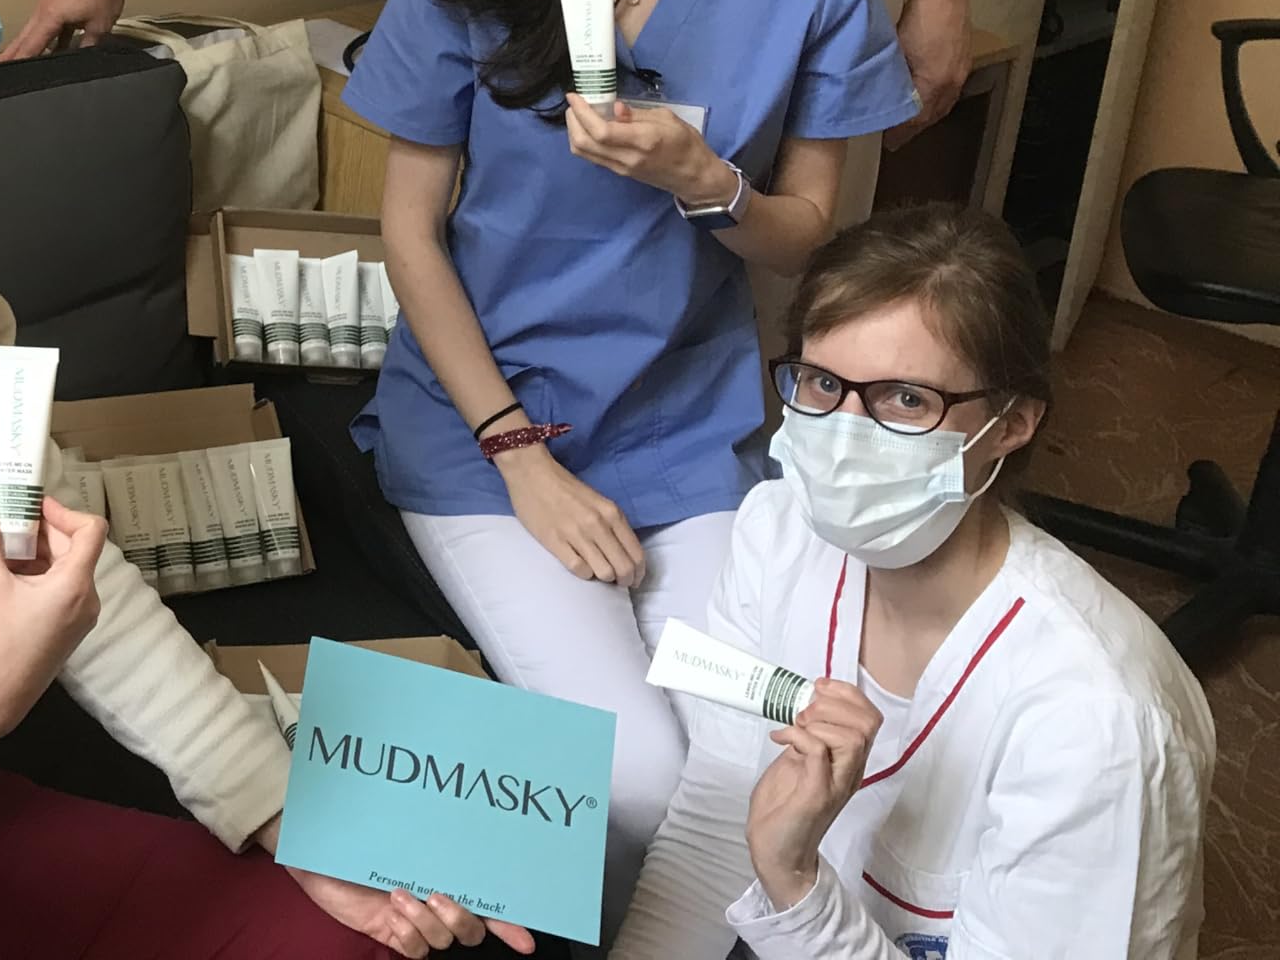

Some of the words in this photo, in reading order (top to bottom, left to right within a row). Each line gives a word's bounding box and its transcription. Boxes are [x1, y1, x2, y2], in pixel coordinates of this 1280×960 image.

[368, 871, 416, 892] Personal
[457, 893, 474, 907] the
[476, 899, 506, 915] back!
